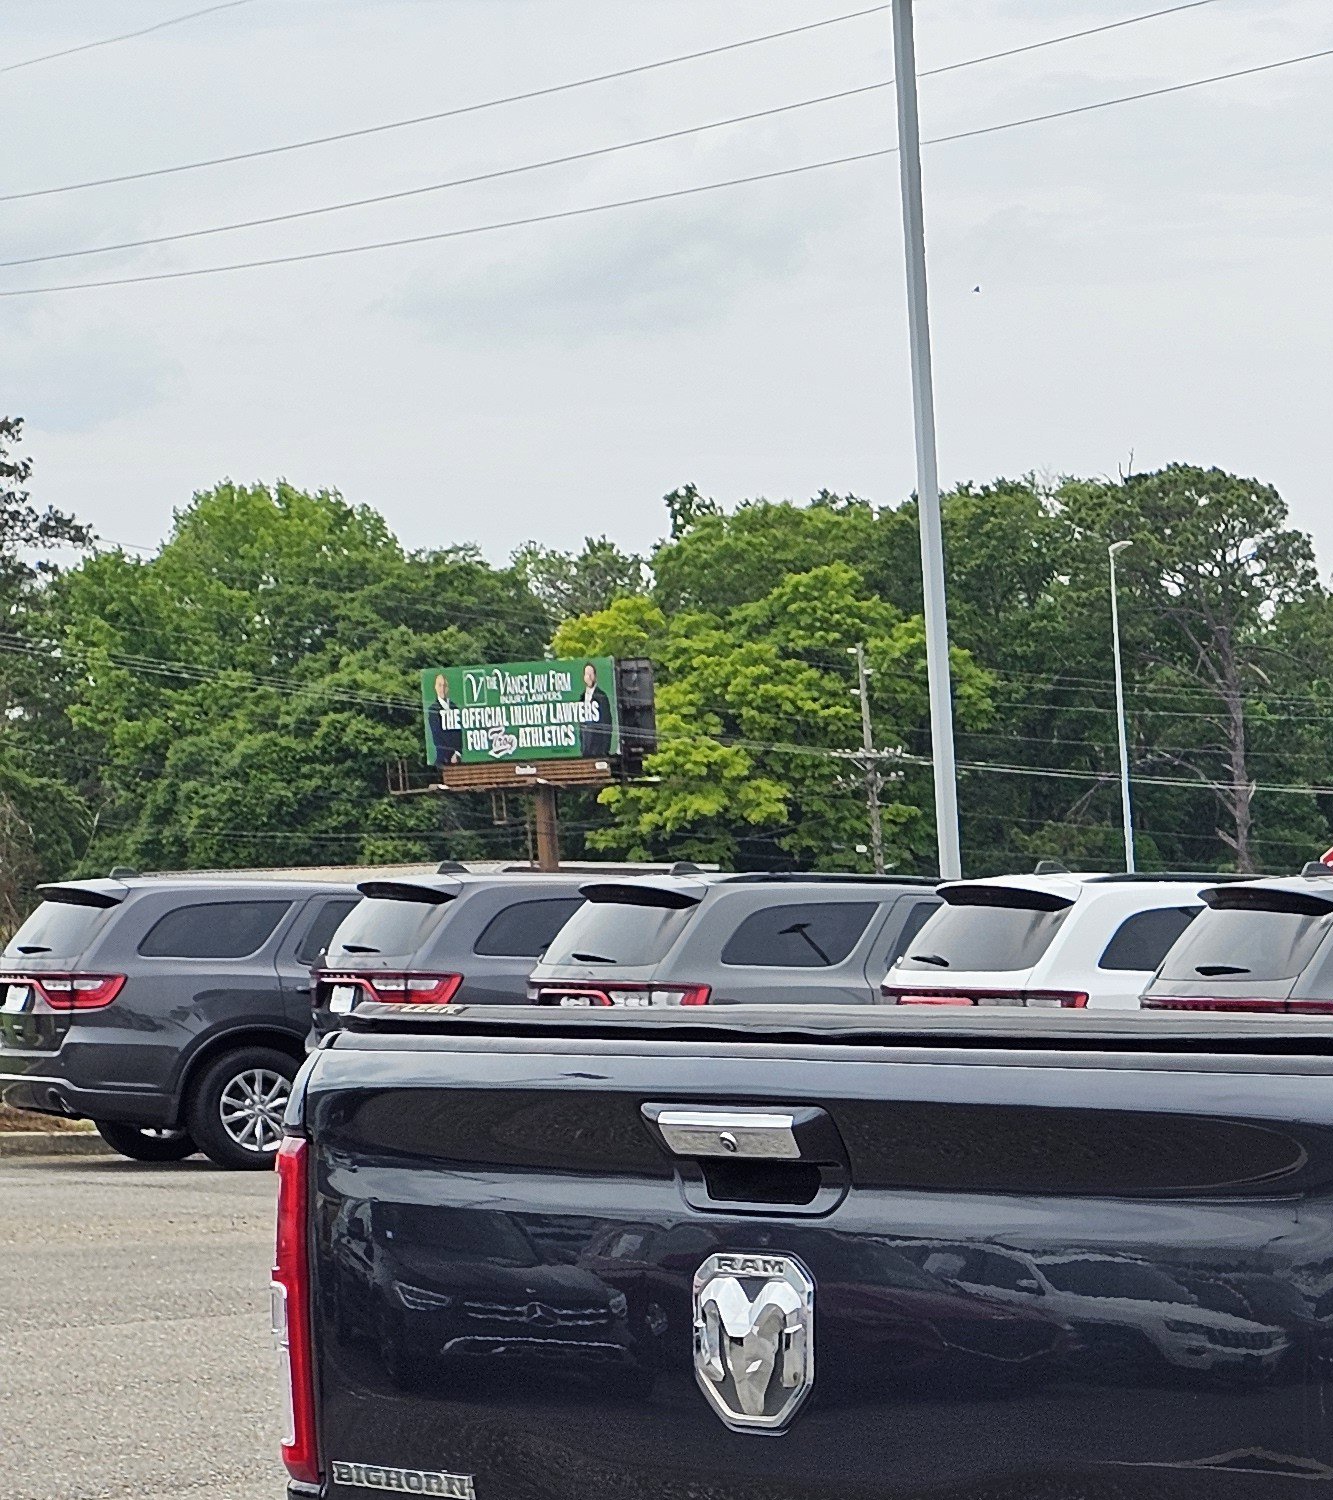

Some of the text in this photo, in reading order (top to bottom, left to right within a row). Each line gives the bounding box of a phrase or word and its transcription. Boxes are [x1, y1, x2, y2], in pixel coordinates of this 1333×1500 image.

[492, 669, 528, 695] VANCE
[528, 671, 548, 693] LAW
[549, 670, 572, 692] FIRM
[527, 690, 562, 702] LAWYERS
[440, 701, 600, 730] THE OFFICIAL INJURY LAWYERS
[467, 729, 489, 751] FOR
[518, 725, 575, 748] ATHLETICS
[717, 1258, 784, 1274] RAM
[332, 1461, 476, 1500] BIGHORN
